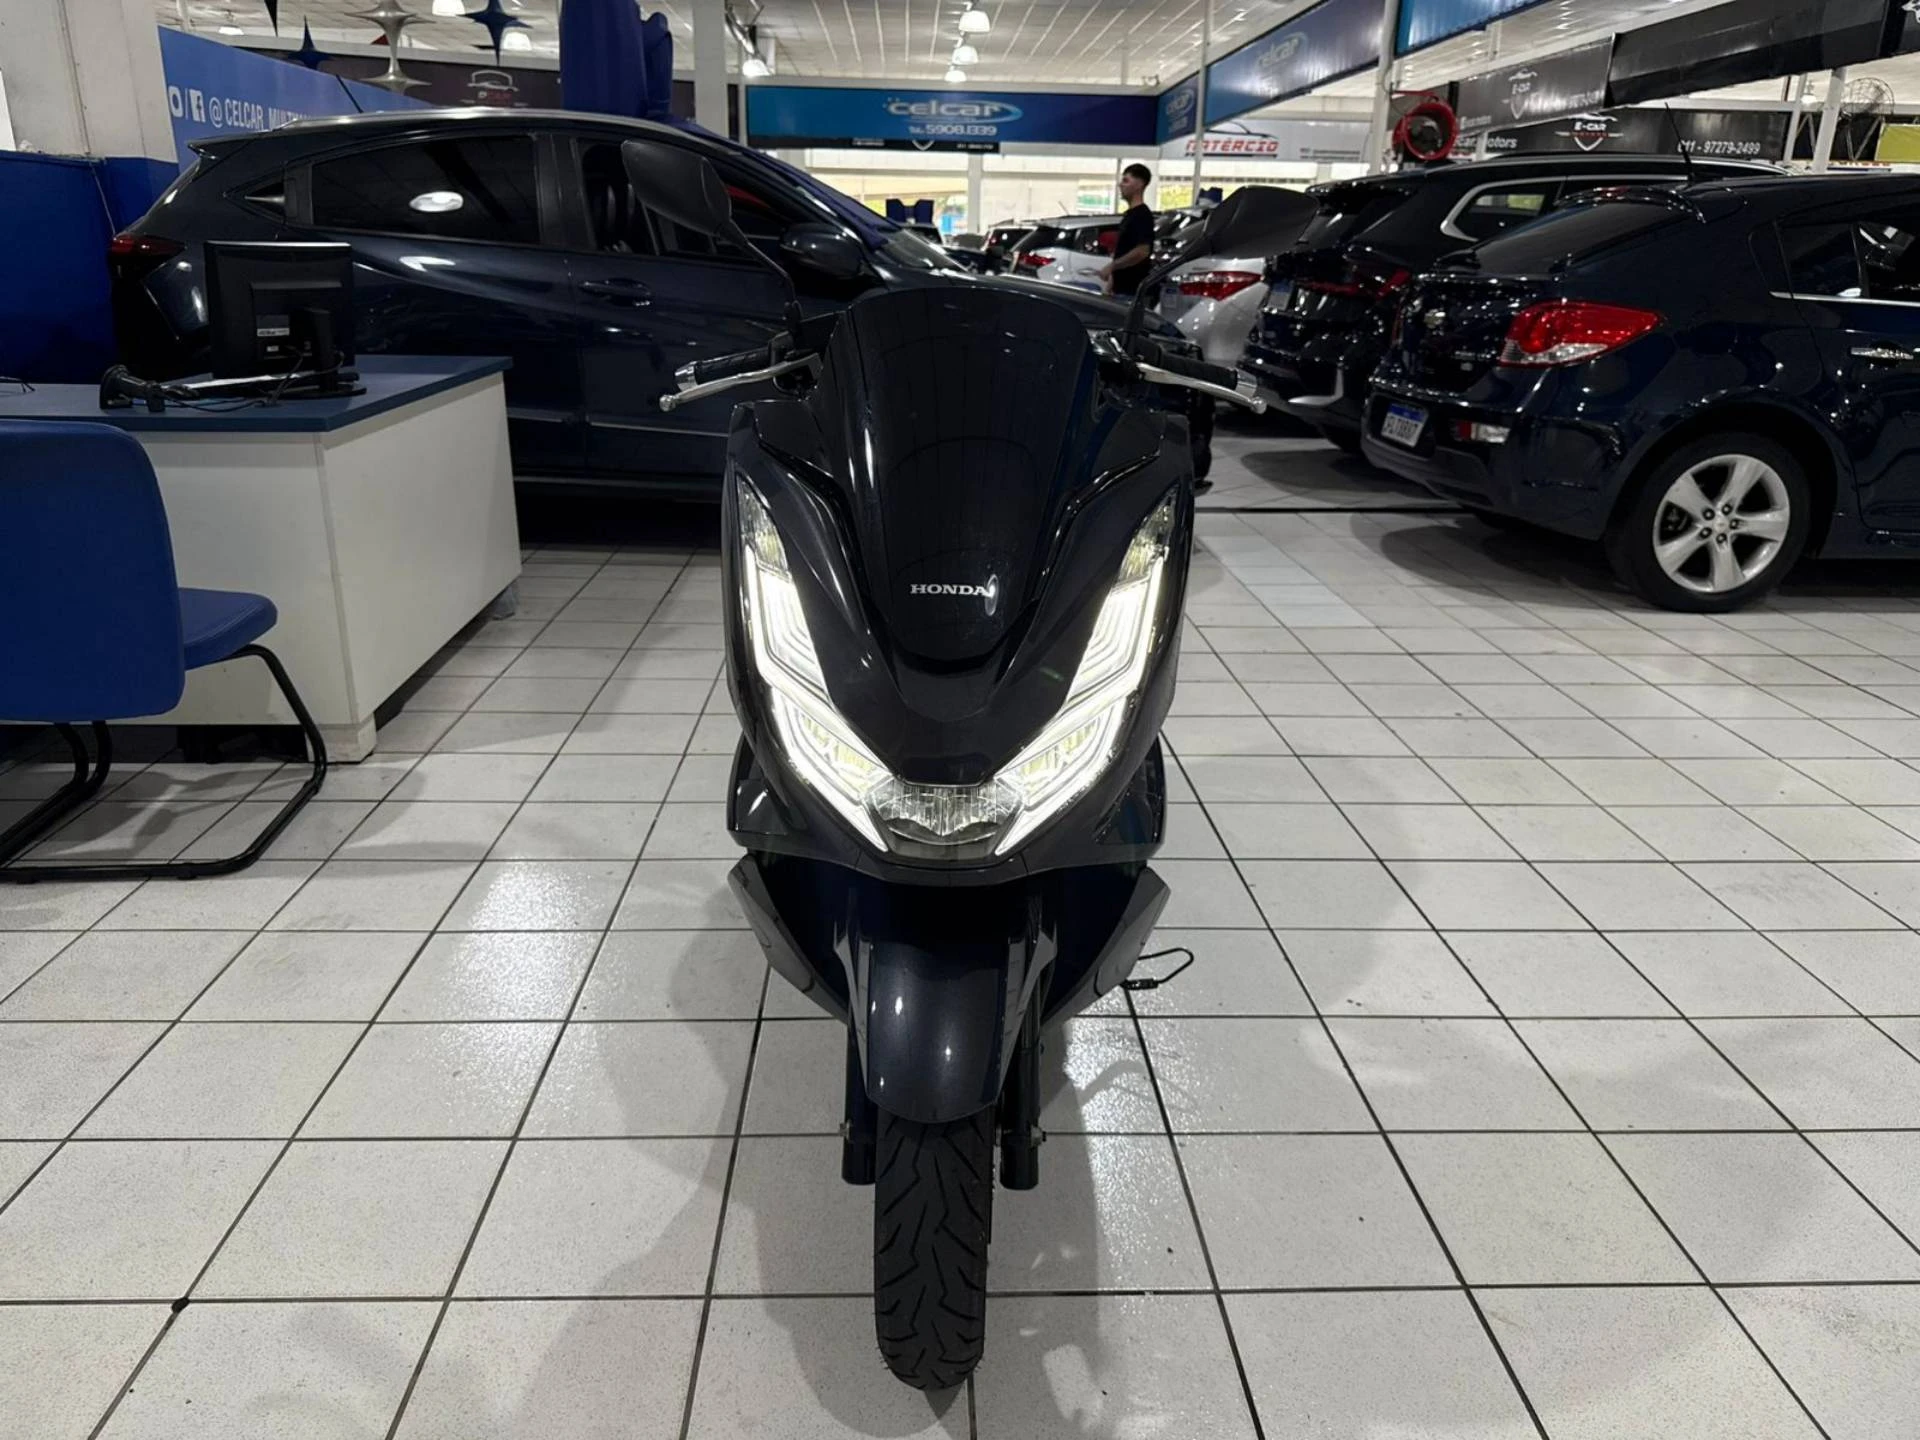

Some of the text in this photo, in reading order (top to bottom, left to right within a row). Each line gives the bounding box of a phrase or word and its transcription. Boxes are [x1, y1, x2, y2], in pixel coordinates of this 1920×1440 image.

[888, 100, 1000, 117] celcar
[1574, 121, 1607, 131] E-CAR
[910, 584, 990, 596] HONDA
